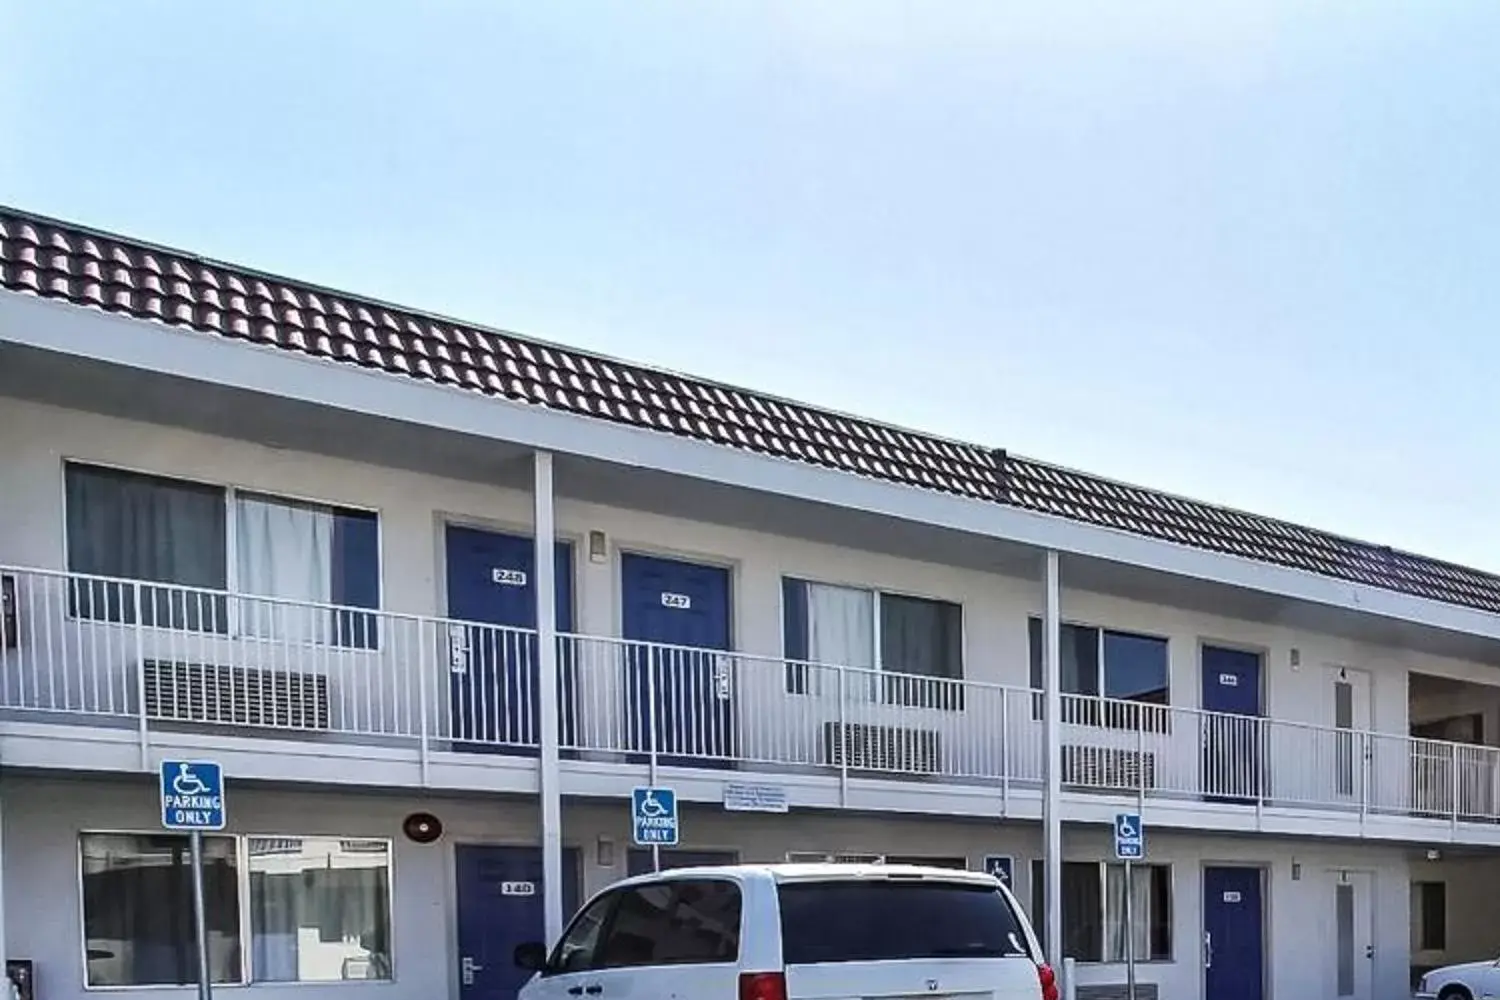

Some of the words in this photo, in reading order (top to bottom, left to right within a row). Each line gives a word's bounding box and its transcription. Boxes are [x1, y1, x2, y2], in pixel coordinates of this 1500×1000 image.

[165, 795, 221, 810] PARKING
[175, 810, 212, 824] ONLY
[636, 816, 677, 828] PARKING
